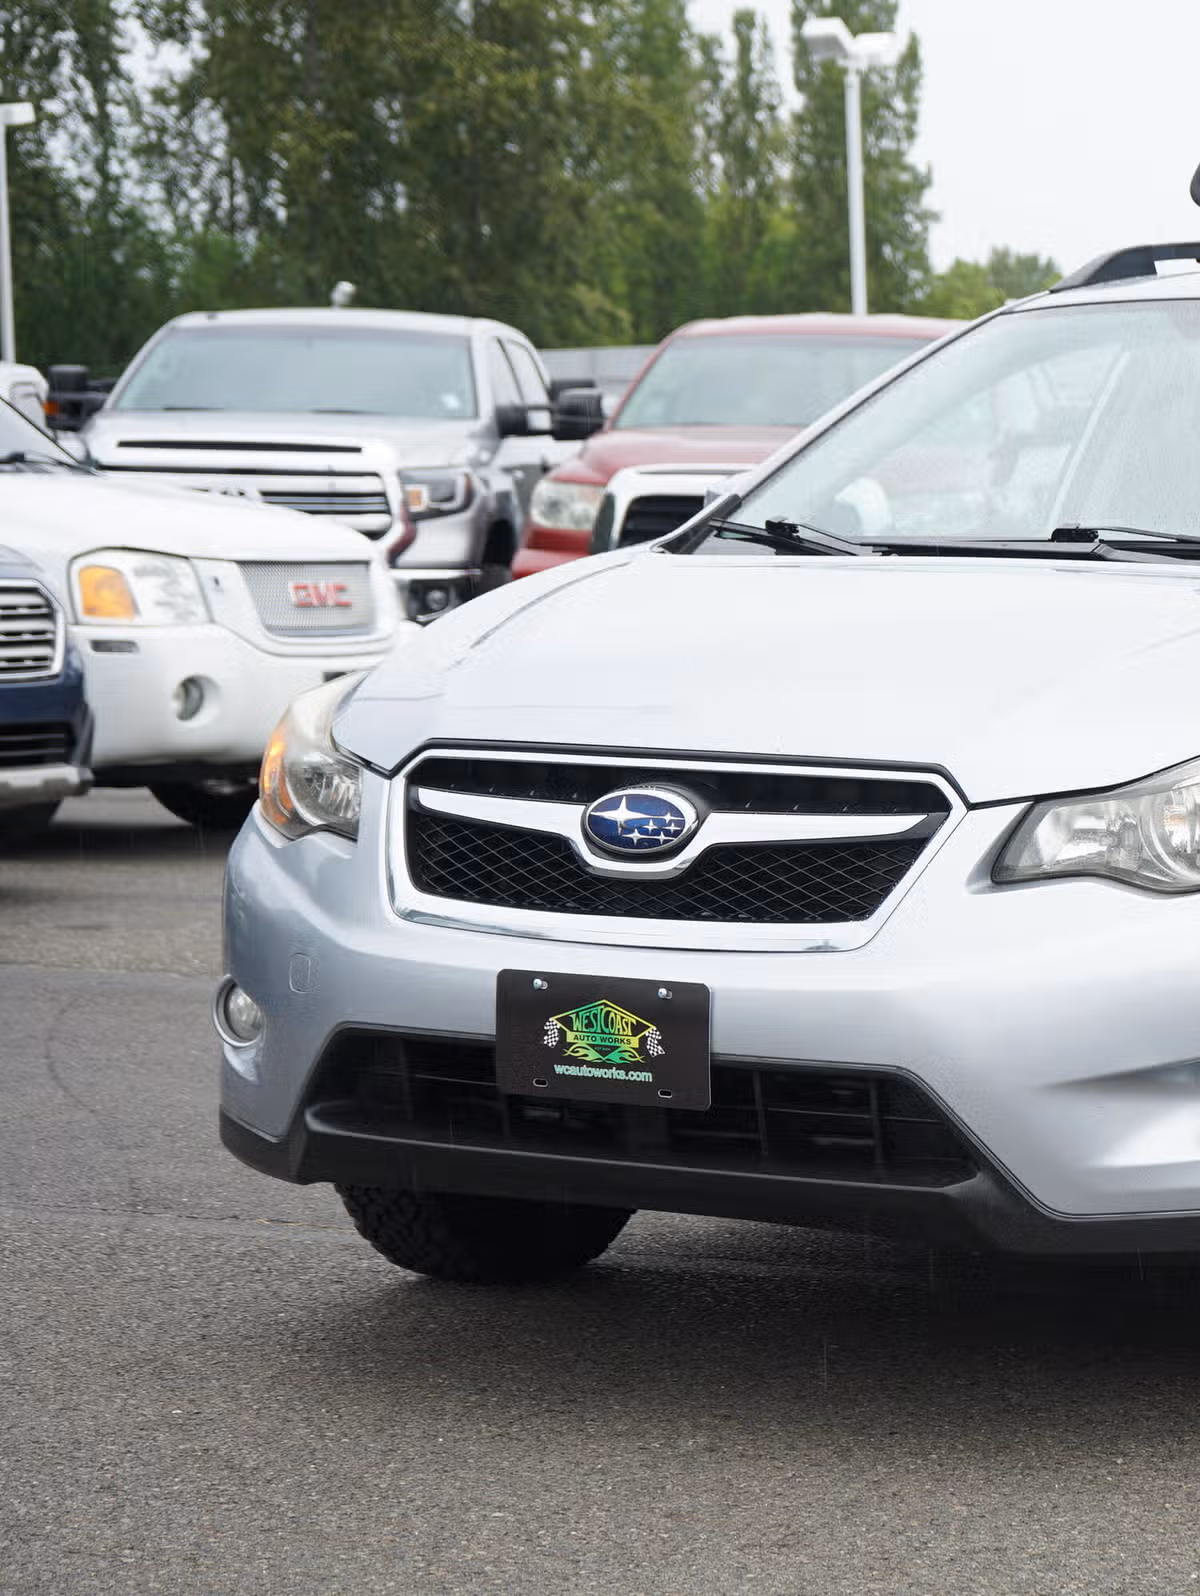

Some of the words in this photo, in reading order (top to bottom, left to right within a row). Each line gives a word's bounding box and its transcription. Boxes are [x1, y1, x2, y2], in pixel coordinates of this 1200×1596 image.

[291, 582, 352, 607] GMC
[573, 1034, 597, 1043] AUTO
[600, 1035, 632, 1045] WORKS
[554, 1064, 653, 1082] wcautoworks.com
